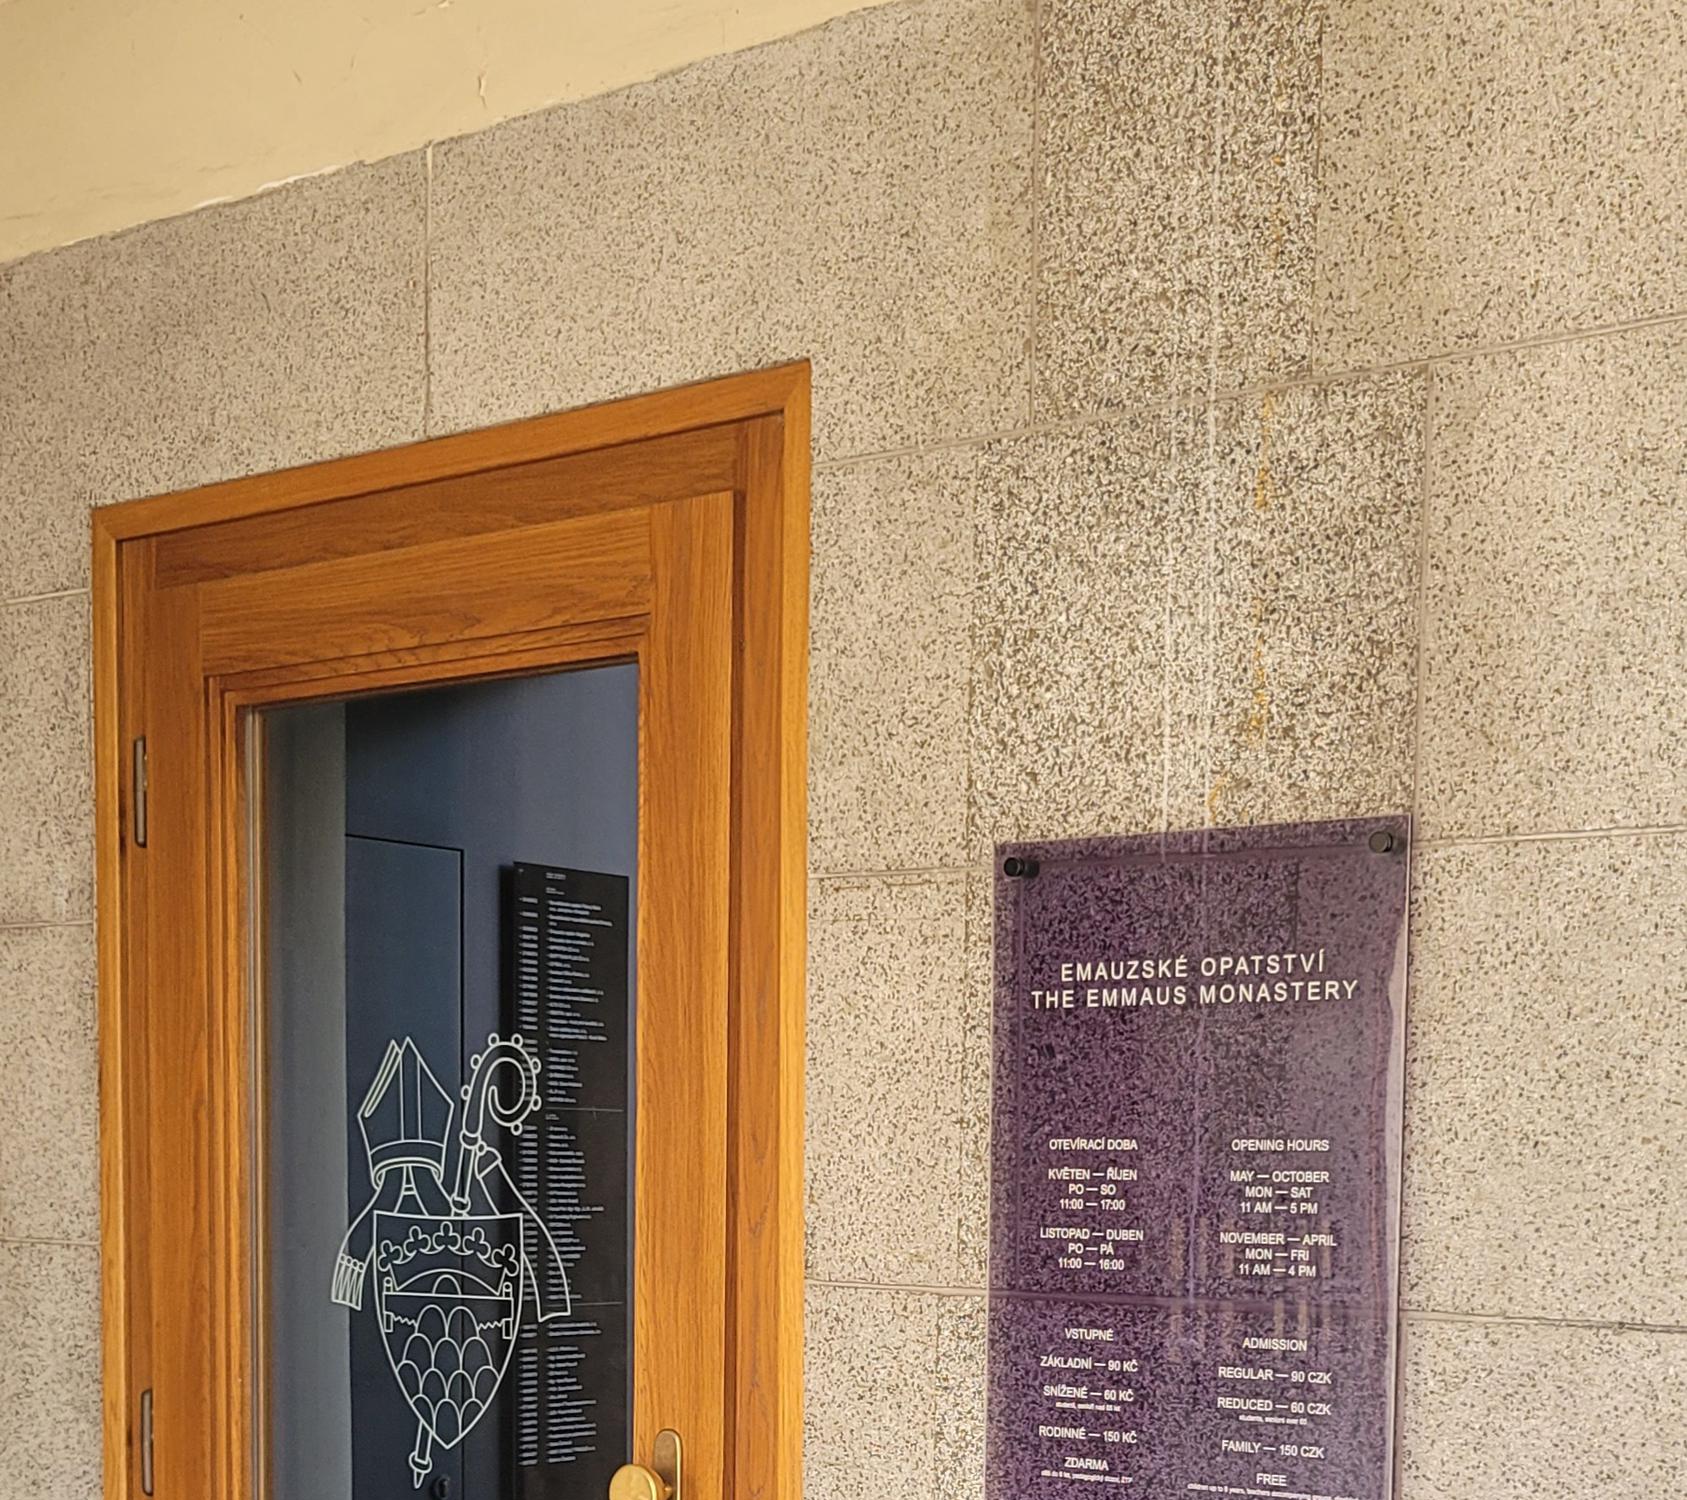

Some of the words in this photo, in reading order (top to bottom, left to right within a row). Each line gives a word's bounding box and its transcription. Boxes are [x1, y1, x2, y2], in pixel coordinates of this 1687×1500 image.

[1061, 955, 1188, 982] EMAUZSKÉ
[1200, 949, 1325, 977] OPATSTVÍ
[1031, 991, 1074, 1009] THE
[1087, 986, 1186, 1008] EMMAUS
[1200, 980, 1358, 1005] MONASTERY
[1049, 1137, 1105, 1150] OTEVÍRACÍ
[1107, 1139, 1138, 1150] DOBA
[1232, 1139, 1284, 1151] OPENING
[1287, 1140, 1329, 1151] HOURS
[1048, 1167, 1090, 1179] KVĚTEN
[1107, 1167, 1137, 1180] ŘÍJEN
[1230, 1171, 1254, 1181] MAY
[1272, 1171, 1329, 1182] OCTOBER
[1069, 1184, 1084, 1194] PO
[1100, 1184, 1116, 1195] SO
[1245, 1186, 1272, 1197] MON
[1291, 1187, 1313, 1198] SAT
[1060, 1199, 1083, 1209] 11:00
[1101, 1200, 1125, 1210] 17:00
[1241, 1202, 1250, 1212] 11
[1254, 1202, 1272, 1213] AM
[1290, 1203, 1297, 1214] 5
[1300, 1203, 1318, 1214] PM
[1041, 1228, 1090, 1239] LISTOPAD
[1106, 1229, 1143, 1240] DUBEN
[1220, 1232, 1285, 1244] NOVEMBER
[1302, 1235, 1337, 1246] APRIL
[1068, 1243, 1083, 1253] PO
[1100, 1242, 1114, 1255] PÁ
[1245, 1248, 1272, 1259] MON
[1291, 1250, 1309, 1261] FRI
[1059, 1258, 1082, 1268] 11:00
[1099, 1259, 1124, 1270] 16:00
[1239, 1264, 1248, 1274] 11
[1252, 1264, 1270, 1275] AM
[1288, 1266, 1295, 1276] 4
[1298, 1266, 1316, 1276] PM
[1065, 1328, 1114, 1341] VSTUPNÉ
[1243, 1338, 1307, 1351] ADMISSION
[1040, 1355, 1092, 1369] ZÁKLADNÍ
[1108, 1360, 1121, 1371] 90
[1123, 1359, 1138, 1372] KČ
[1218, 1367, 1274, 1380] REGULAR
[1291, 1371, 1305, 1382] 90
[1308, 1372, 1332, 1384] CZK
[1044, 1384, 1088, 1398] SNÍŽENÉ
[1104, 1390, 1116, 1400] 60
[1119, 1388, 1134, 1401] KČ
[1217, 1397, 1272, 1411] REDUCED
[1291, 1402, 1304, 1413] 60
[1307, 1403, 1331, 1415] CZK
[1039, 1426, 1086, 1439] RODINNÉ
[1103, 1431, 1120, 1442] 150
[1122, 1431, 1137, 1443] KČ
[1222, 1440, 1261, 1453] FAMILY
[1280, 1445, 1298, 1456] 150
[1301, 1446, 1324, 1459] CZK
[1065, 1457, 1109, 1471] ZDARMA
[1256, 1473, 1287, 1486] FREE
